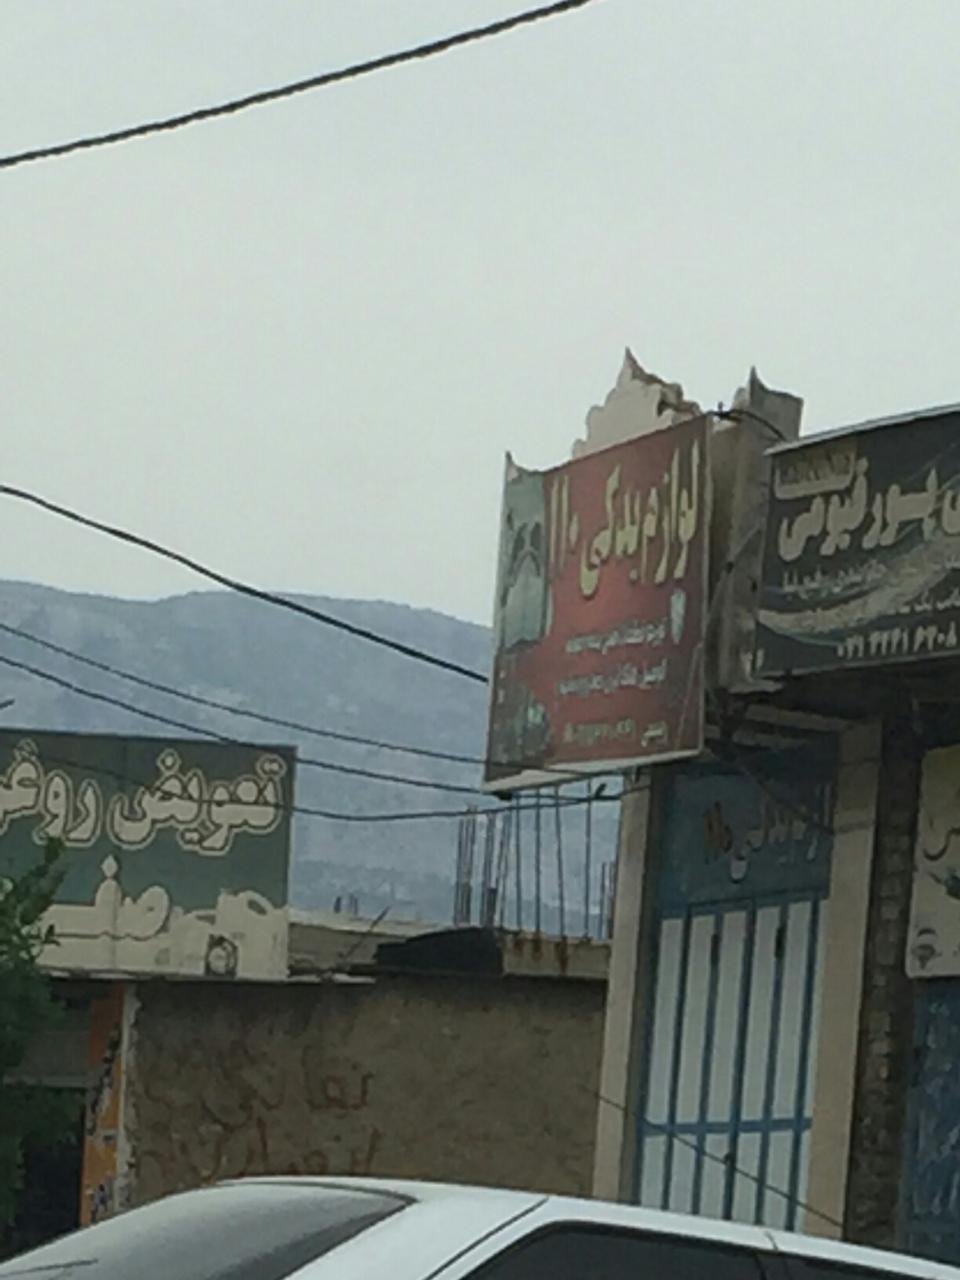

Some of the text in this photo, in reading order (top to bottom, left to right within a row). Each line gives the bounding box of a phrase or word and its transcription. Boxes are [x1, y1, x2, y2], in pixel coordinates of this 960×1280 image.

[579, 464, 641, 598] یدکی
[641, 439, 700, 586] لوازم
[0, 740, 284, 853] تعویض روغ
